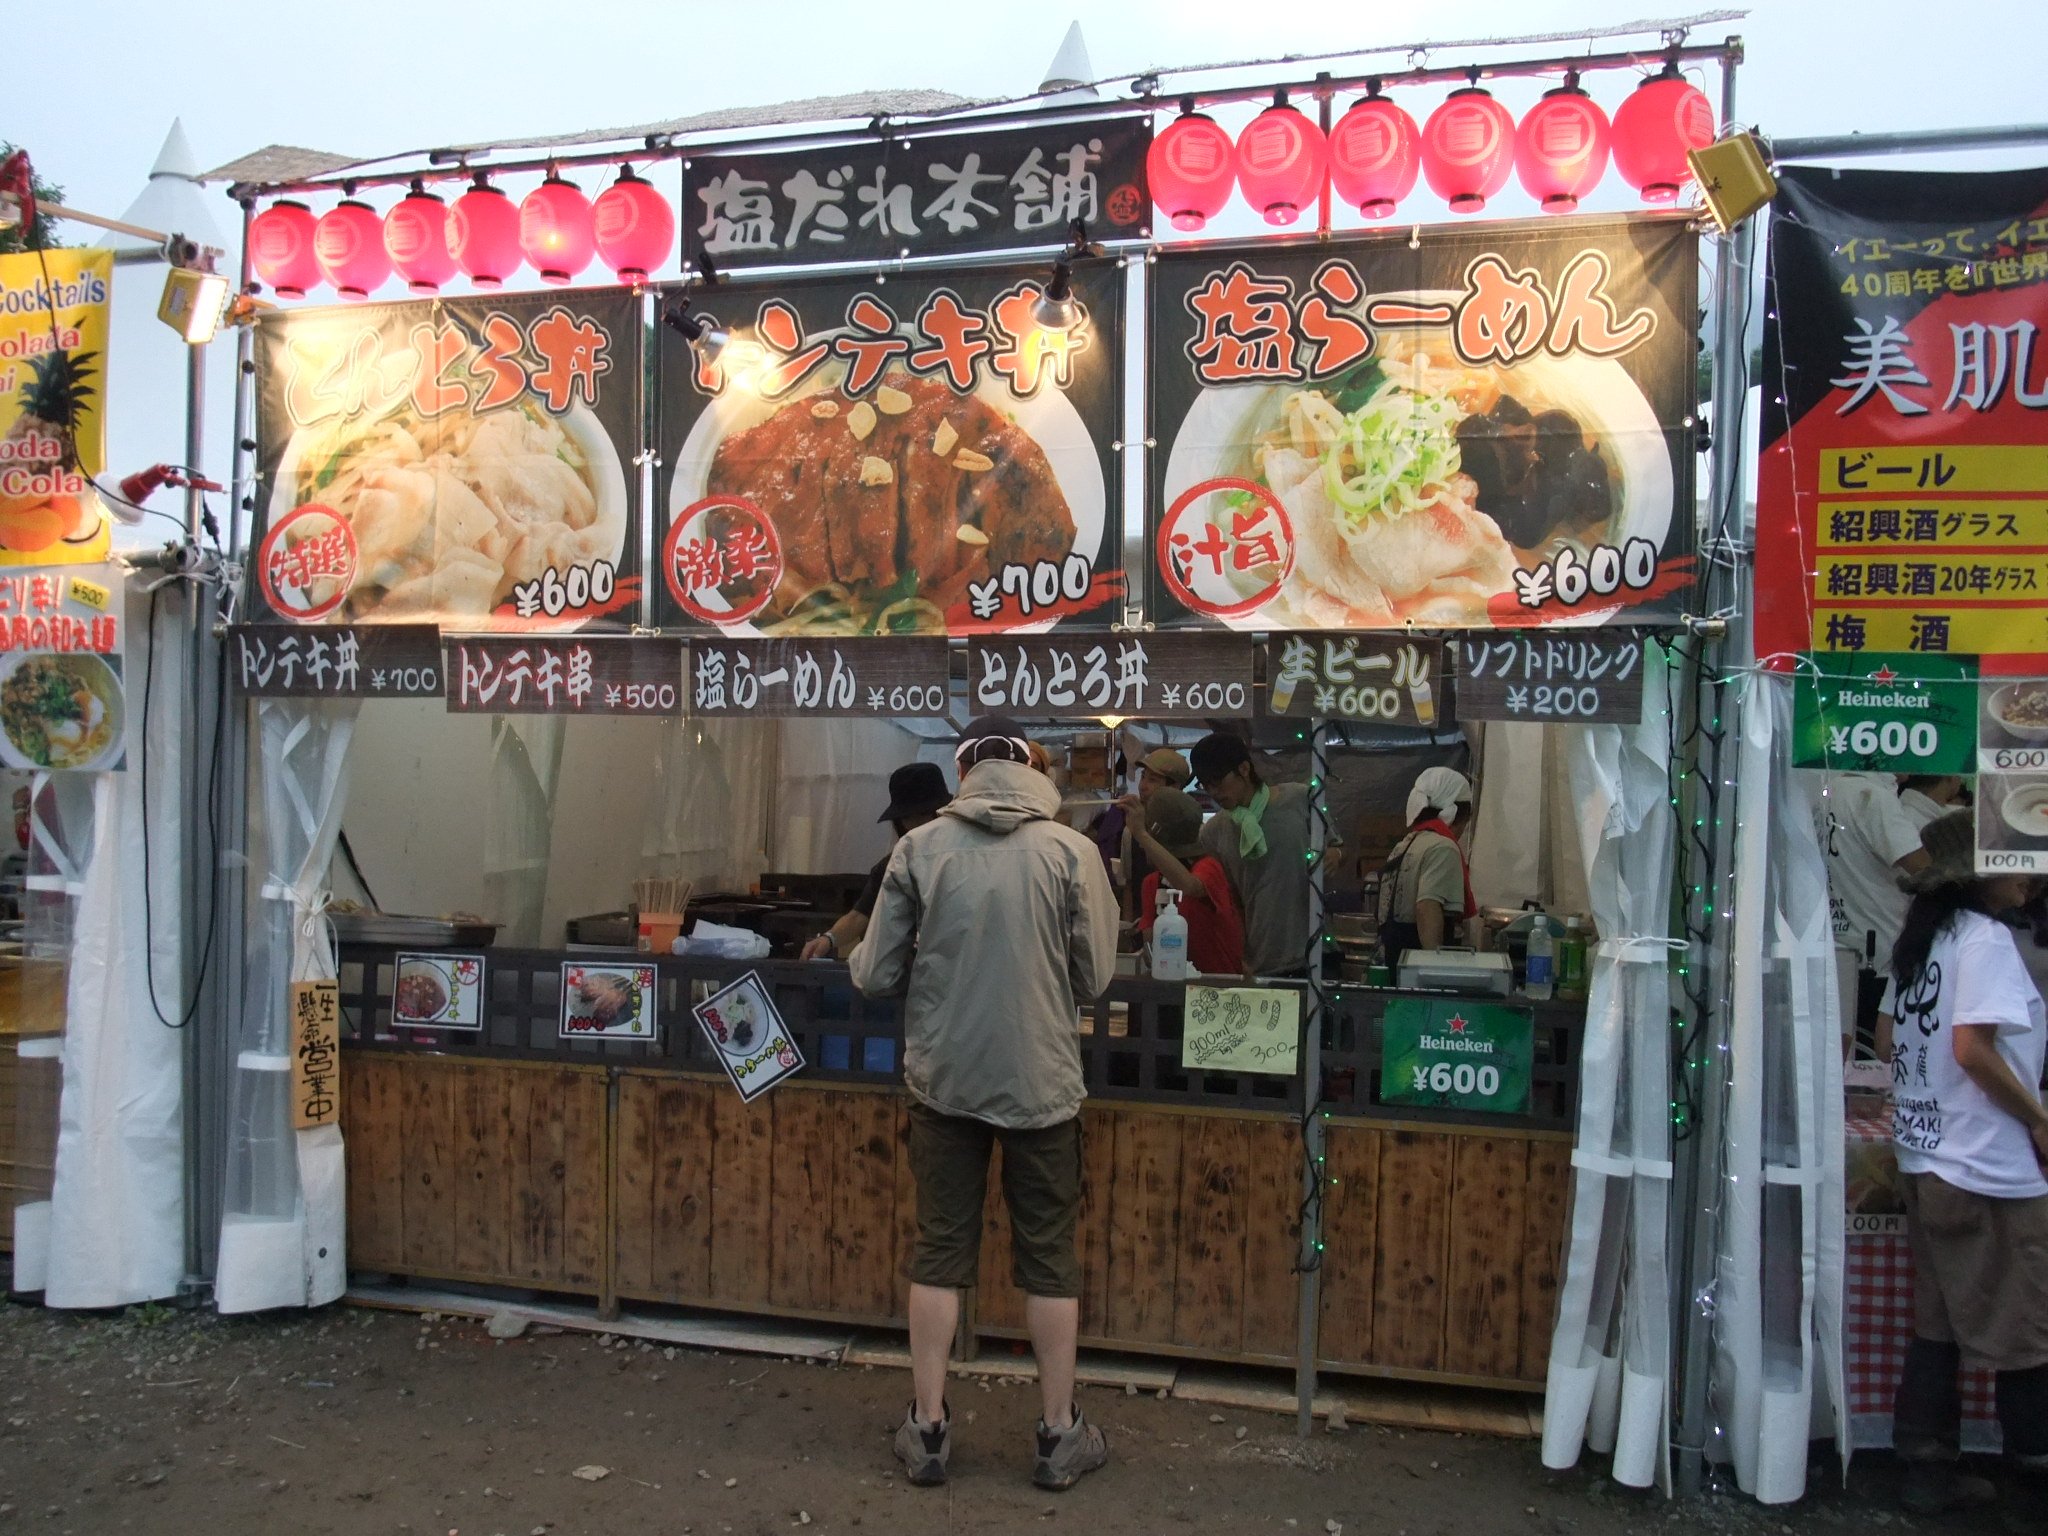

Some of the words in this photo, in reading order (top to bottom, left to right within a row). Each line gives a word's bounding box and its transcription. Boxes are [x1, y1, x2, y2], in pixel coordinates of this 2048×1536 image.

[697, 138, 1102, 254] 塩だれ本舗
[0, 271, 105, 313] ocktails
[1184, 248, 1657, 387] 塩らーめん
[2, 467, 83, 496] Cola
[1838, 452, 1956, 489] ビール
[1829, 508, 2019, 543] 紹興酒グラス
[270, 526, 349, 591] 特選
[1513, 536, 1658, 609] ¥600
[1827, 562, 2037, 596] 紹興酒20年グラス
[72, 581, 103, 606] ¥500
[513, 560, 615, 618] ¥600
[967, 553, 1093, 619] ¥700
[239, 630, 360, 690] トンテキ丼
[371, 668, 437, 691] ¥700
[460, 645, 593, 707] トンテキ串
[605, 684, 675, 709] ¥500
[696, 646, 856, 711] 塩らーめん
[867, 685, 944, 712] ¥600
[977, 638, 1149, 710] とんとろ丼
[1161, 680, 1246, 711] ¥600
[1278, 634, 1431, 688] 生ビール
[1467, 640, 1640, 681] ソフトドリンク
[1313, 683, 1400, 719] ¥600
[1506, 684, 1599, 715] ¥200
[1838, 690, 1930, 708] Heineken
[1829, 720, 1938, 757] ¥600
[1189, 1023, 1230, 1056] 900ml
[1420, 1034, 1494, 1053] Heineken
[1412, 1062, 1499, 1096] ¥600
